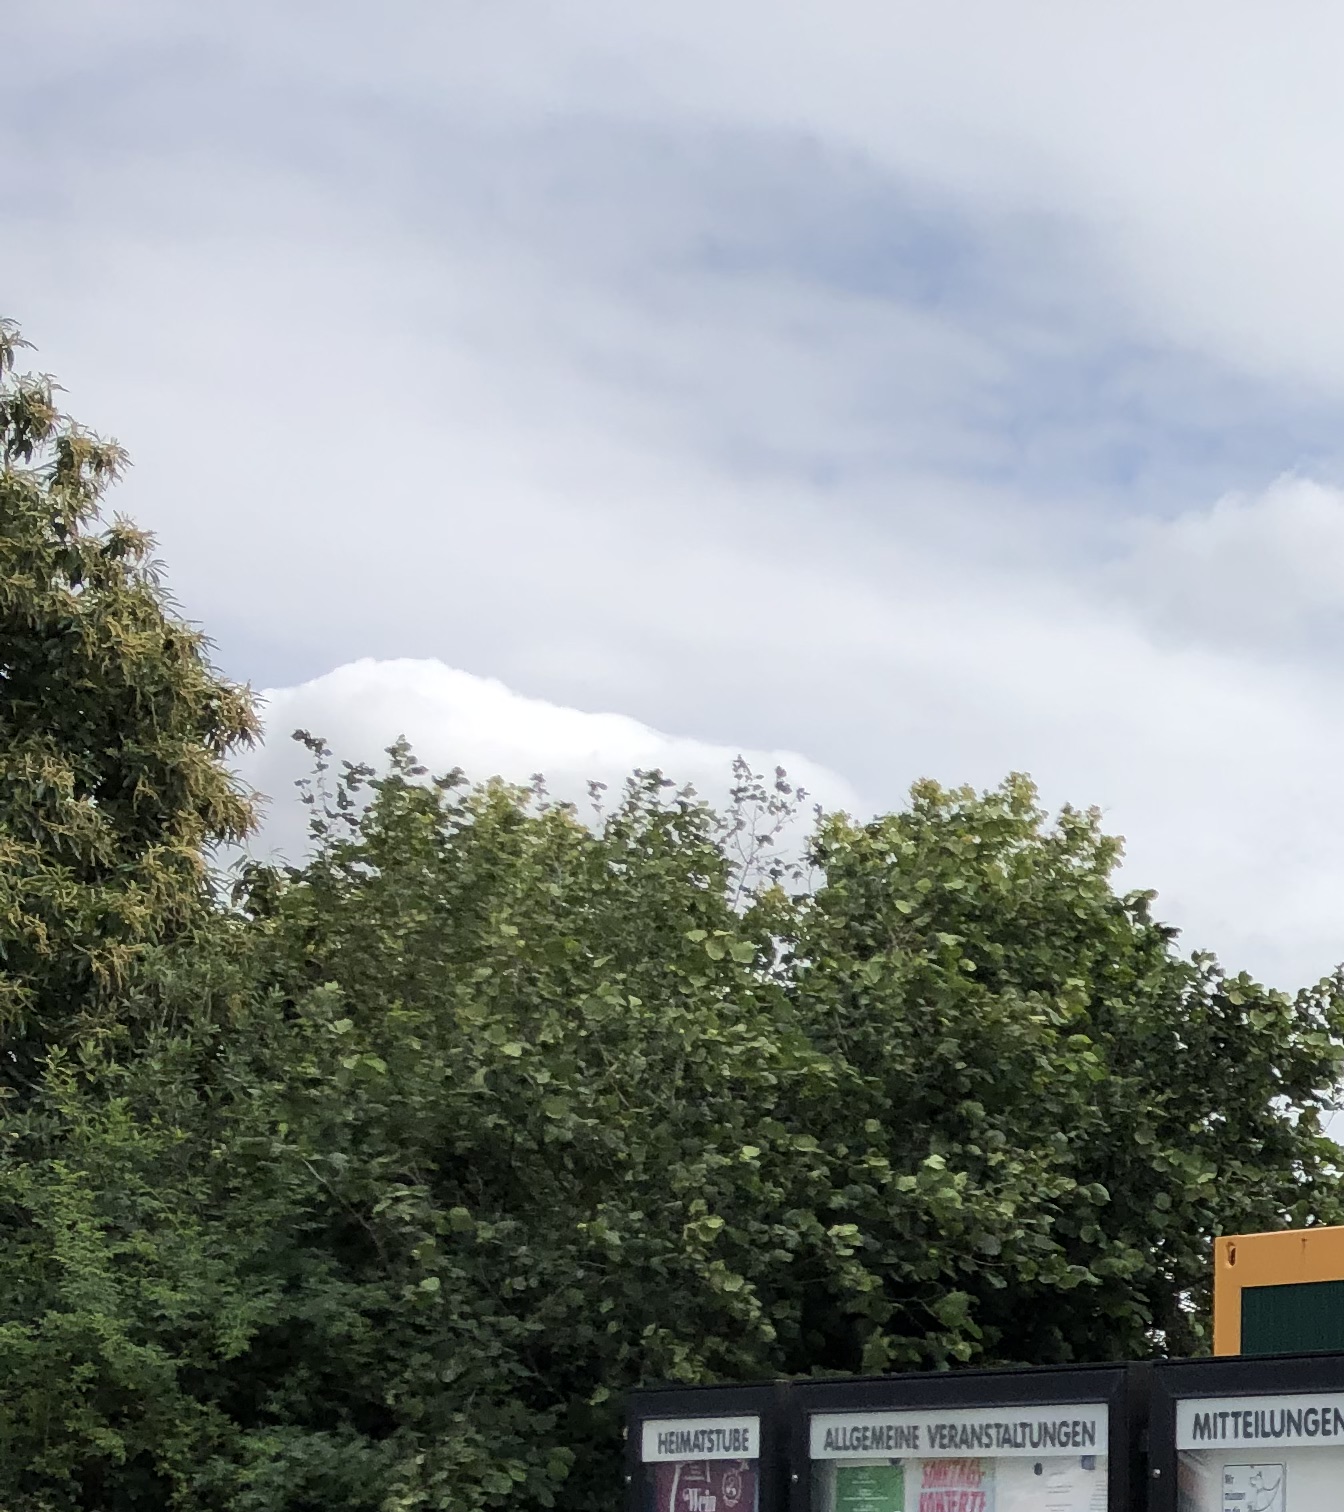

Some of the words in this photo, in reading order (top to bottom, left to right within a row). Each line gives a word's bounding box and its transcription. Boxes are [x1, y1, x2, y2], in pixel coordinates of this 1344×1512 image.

[658, 1428, 749, 1454] HEIMATSTUBE
[824, 1425, 919, 1451] ALLGEMEINE
[927, 1420, 1096, 1450] VERANSTALTUNGEN
